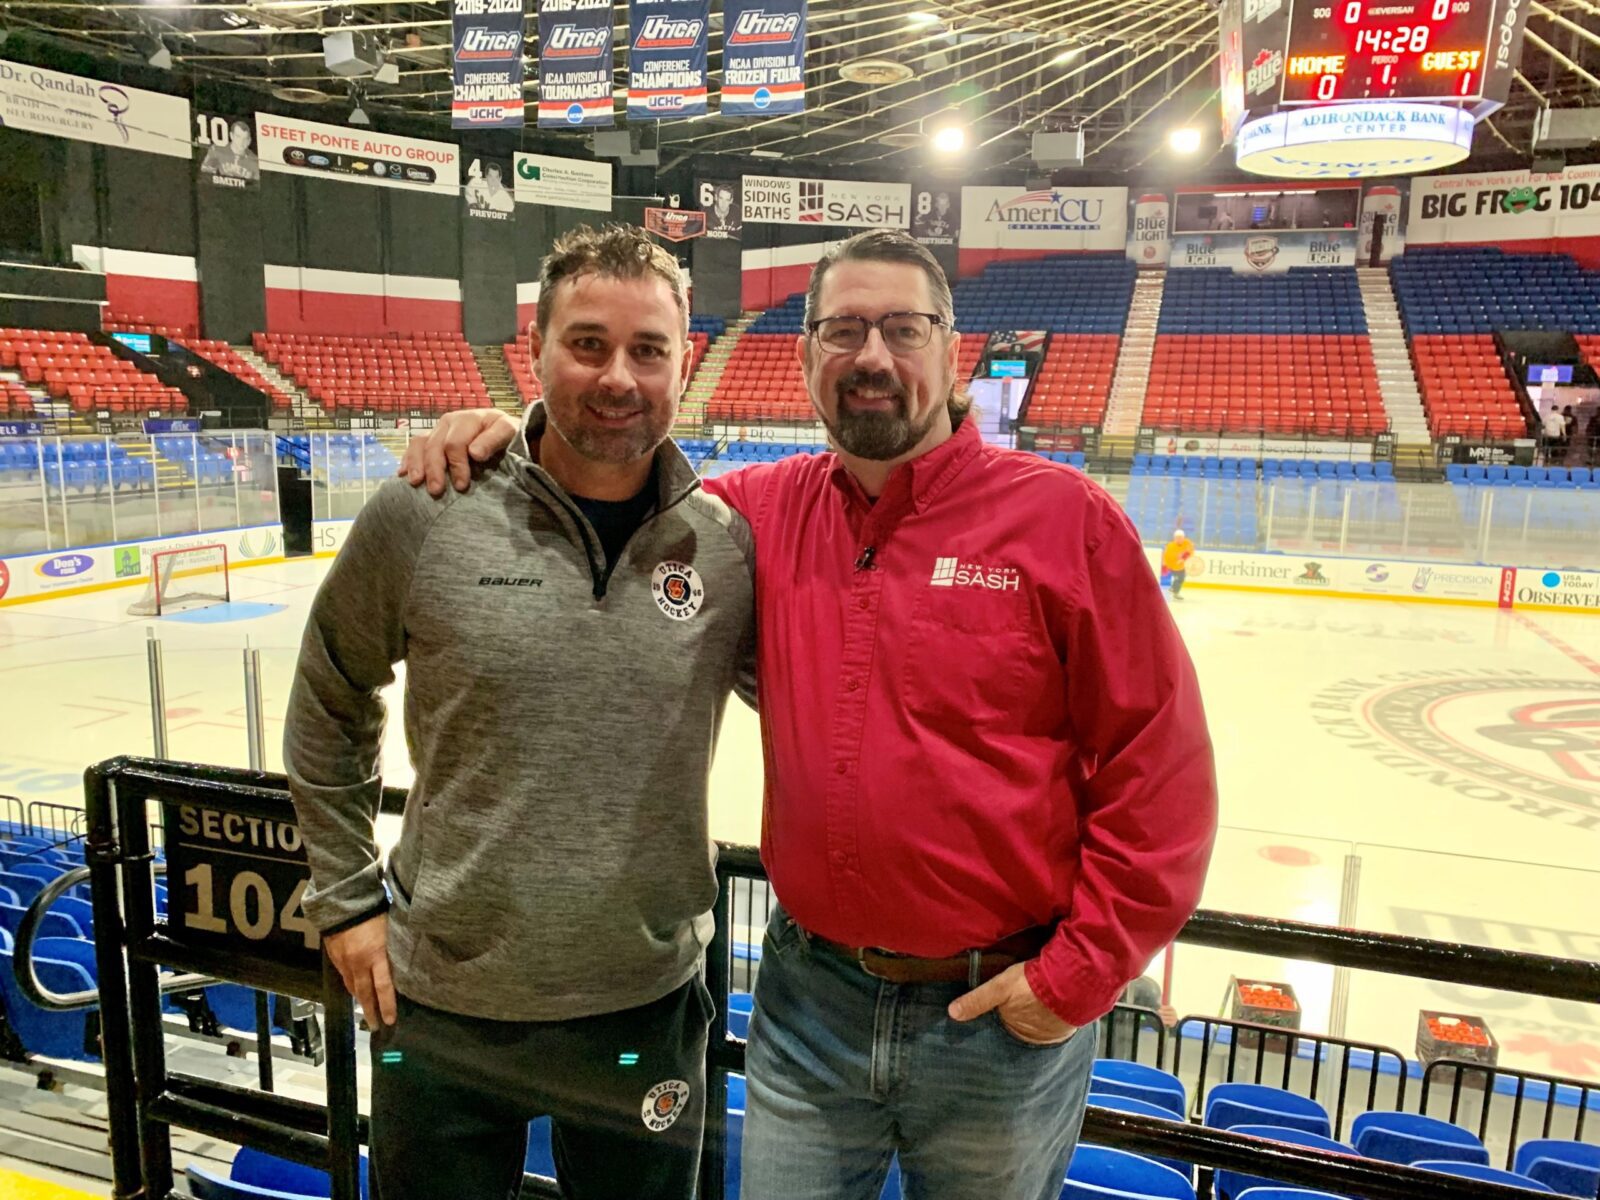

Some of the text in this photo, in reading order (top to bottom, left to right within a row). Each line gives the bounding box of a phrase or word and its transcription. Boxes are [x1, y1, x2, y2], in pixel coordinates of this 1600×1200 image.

[1344, 2, 1361, 24] 0
[1431, 0, 1448, 21] 0
[643, 19, 701, 40] UTICA
[737, 13, 796, 34] UTICA
[463, 30, 518, 51] UTICA
[551, 27, 609, 48] UTICA
[1355, 26, 1429, 53] 14:28
[643, 59, 690, 72] CONFERENCE
[729, 54, 796, 70] NCAA DIVISION III
[1290, 55, 1345, 75] HOME
[1372, 55, 1398, 65] PERIOD
[1421, 50, 1481, 71] GUEST
[0, 64, 26, 84] Dr.
[30, 70, 96, 98] Qandah
[464, 72, 511, 85] CONFERENCE
[565, 71, 597, 84] DIVISION
[598, 70, 607, 82] III
[631, 70, 702, 88] CHAMPIONS
[725, 66, 801, 85] FROZEN FOUR
[1246, 54, 1283, 94] Blue
[1382, 64, 1391, 84] 1
[454, 83, 521, 101] CHAMPIONS
[541, 82, 612, 100] TOURNAMENT
[1317, 75, 1337, 100] 0
[1461, 72, 1471, 95] 1
[648, 96, 683, 107] UCHC
[470, 108, 503, 119] UCHC
[1301, 110, 1406, 128] ADIRONDACK
[1411, 111, 1447, 126] BANK
[197, 114, 229, 147] 10
[1344, 124, 1407, 135] CENTER
[260, 124, 455, 164] STEET PONTE AUTO GROUP
[468, 158, 483, 178] 4
[212, 175, 246, 188] SMITH
[744, 178, 792, 189] WINDOWS
[1433, 177, 1463, 189] Central
[1465, 177, 1483, 187] New
[1486, 175, 1512, 186] York's
[700, 183, 714, 207] 6
[744, 190, 792, 204] SIDING
[830, 192, 857, 200] NEW
[918, 191, 932, 215] 8
[469, 208, 508, 221] PREVOST
[744, 206, 791, 220] BATHS
[827, 202, 904, 224] SASH
[985, 198, 1104, 223] AmeriCU
[1421, 192, 1467, 219] BIG
[1136, 217, 1167, 231] Blue
[1135, 230, 1166, 242] LIGHT
[1186, 242, 1216, 255] Blue
[1309, 240, 1341, 253] Blue
[1184, 255, 1217, 266] LIGHT
[1307, 253, 1341, 264] LIGHT
[53, 556, 82, 570] Don's
[658, 563, 692, 579] UTICA
[1208, 559, 1292, 579] Herkimer
[478, 576, 543, 588] BAUER
[955, 570, 1020, 591] SASH
[1433, 573, 1493, 585] PRECISION
[1563, 574, 1582, 582] USA
[1563, 580, 1594, 589] TODAY
[657, 596, 697, 618] HOCKEY
[179, 803, 303, 853] SECTIO
[184, 862, 322, 951] 104
[648, 1082, 681, 1099] UTICA
[648, 1102, 683, 1130] HOCKEY
